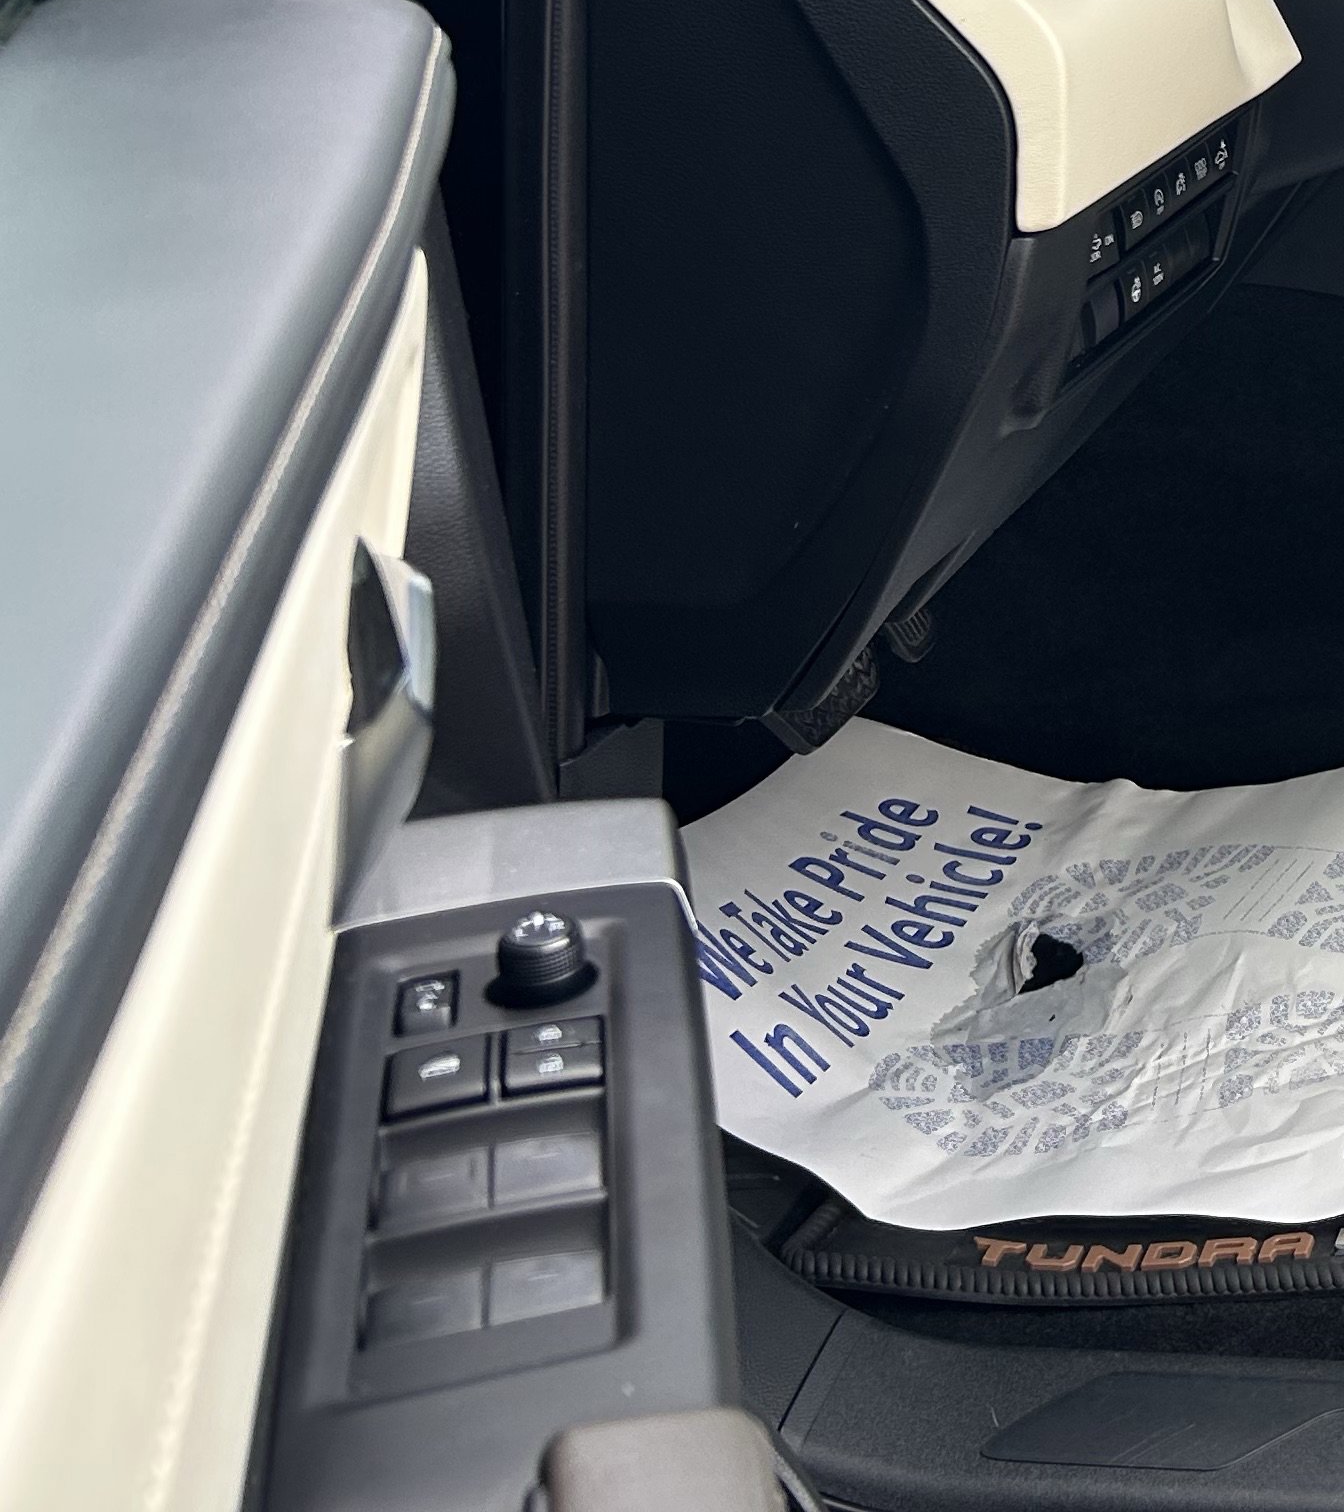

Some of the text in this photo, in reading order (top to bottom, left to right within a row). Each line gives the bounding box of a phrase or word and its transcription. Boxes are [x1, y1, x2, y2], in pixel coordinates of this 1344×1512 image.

[697, 797, 940, 1001] We Take Pride
[728, 804, 1044, 1099] In Your Vehicle!
[974, 1232, 1316, 1274] TUNDRA
